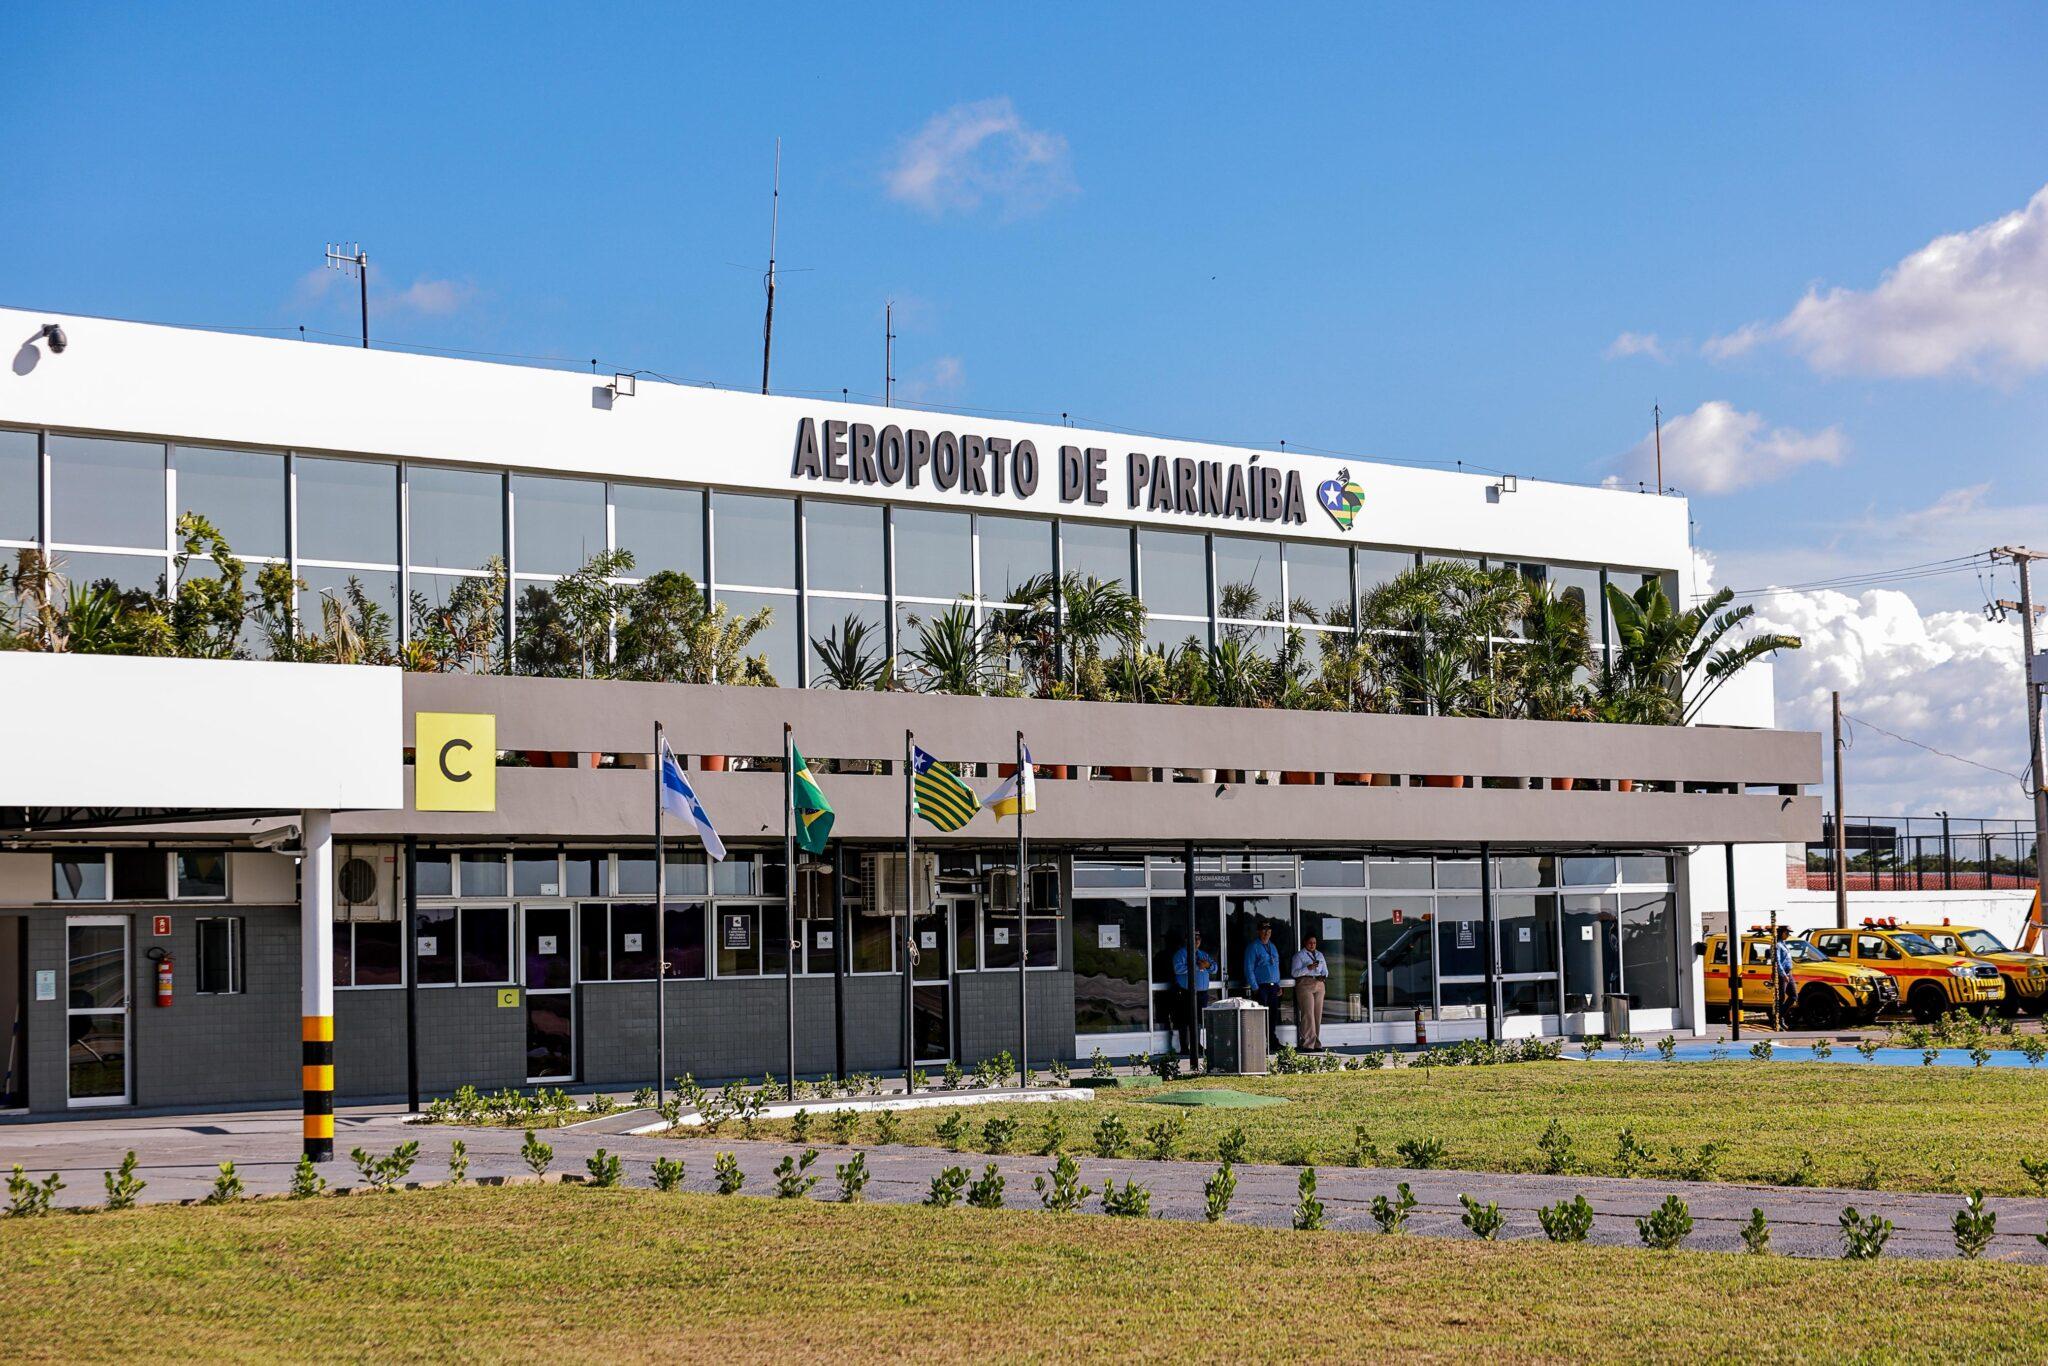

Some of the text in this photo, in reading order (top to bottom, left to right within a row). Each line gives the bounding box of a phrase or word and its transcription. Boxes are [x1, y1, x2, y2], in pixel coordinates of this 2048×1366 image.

[791, 417, 1307, 524] AEROPORTO DE PARNAÍBA
[439, 739, 473, 782] C
[504, 993, 513, 1004] C
